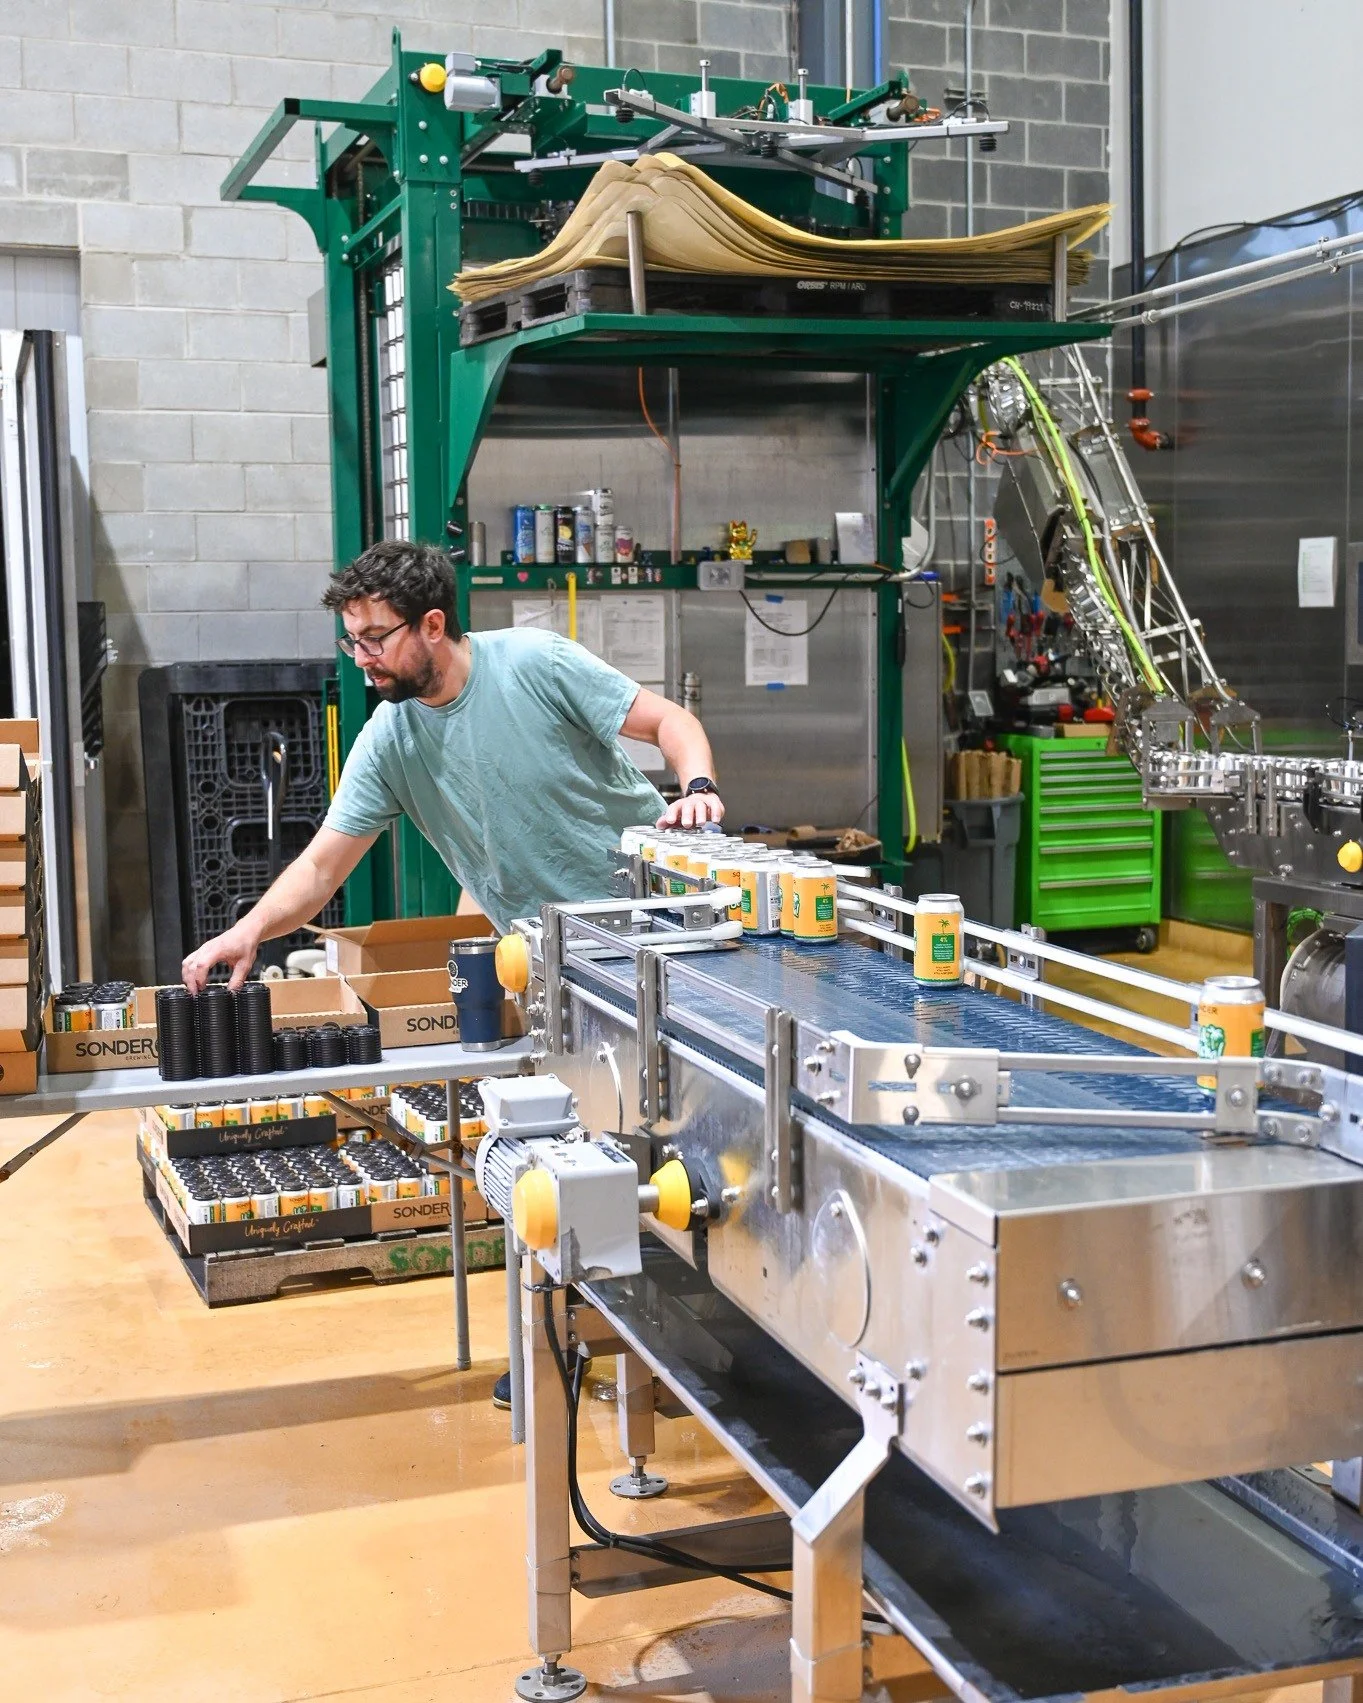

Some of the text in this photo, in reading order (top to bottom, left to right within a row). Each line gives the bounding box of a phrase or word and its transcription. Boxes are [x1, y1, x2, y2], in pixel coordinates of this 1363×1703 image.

[406, 1014, 460, 1032] SOND
[75, 1038, 158, 1058] SONDER
[219, 1126, 284, 1145] Uniquely Crafted
[393, 1202, 452, 1218] SONDER
[244, 1218, 316, 1239] Uniquely Crafted
